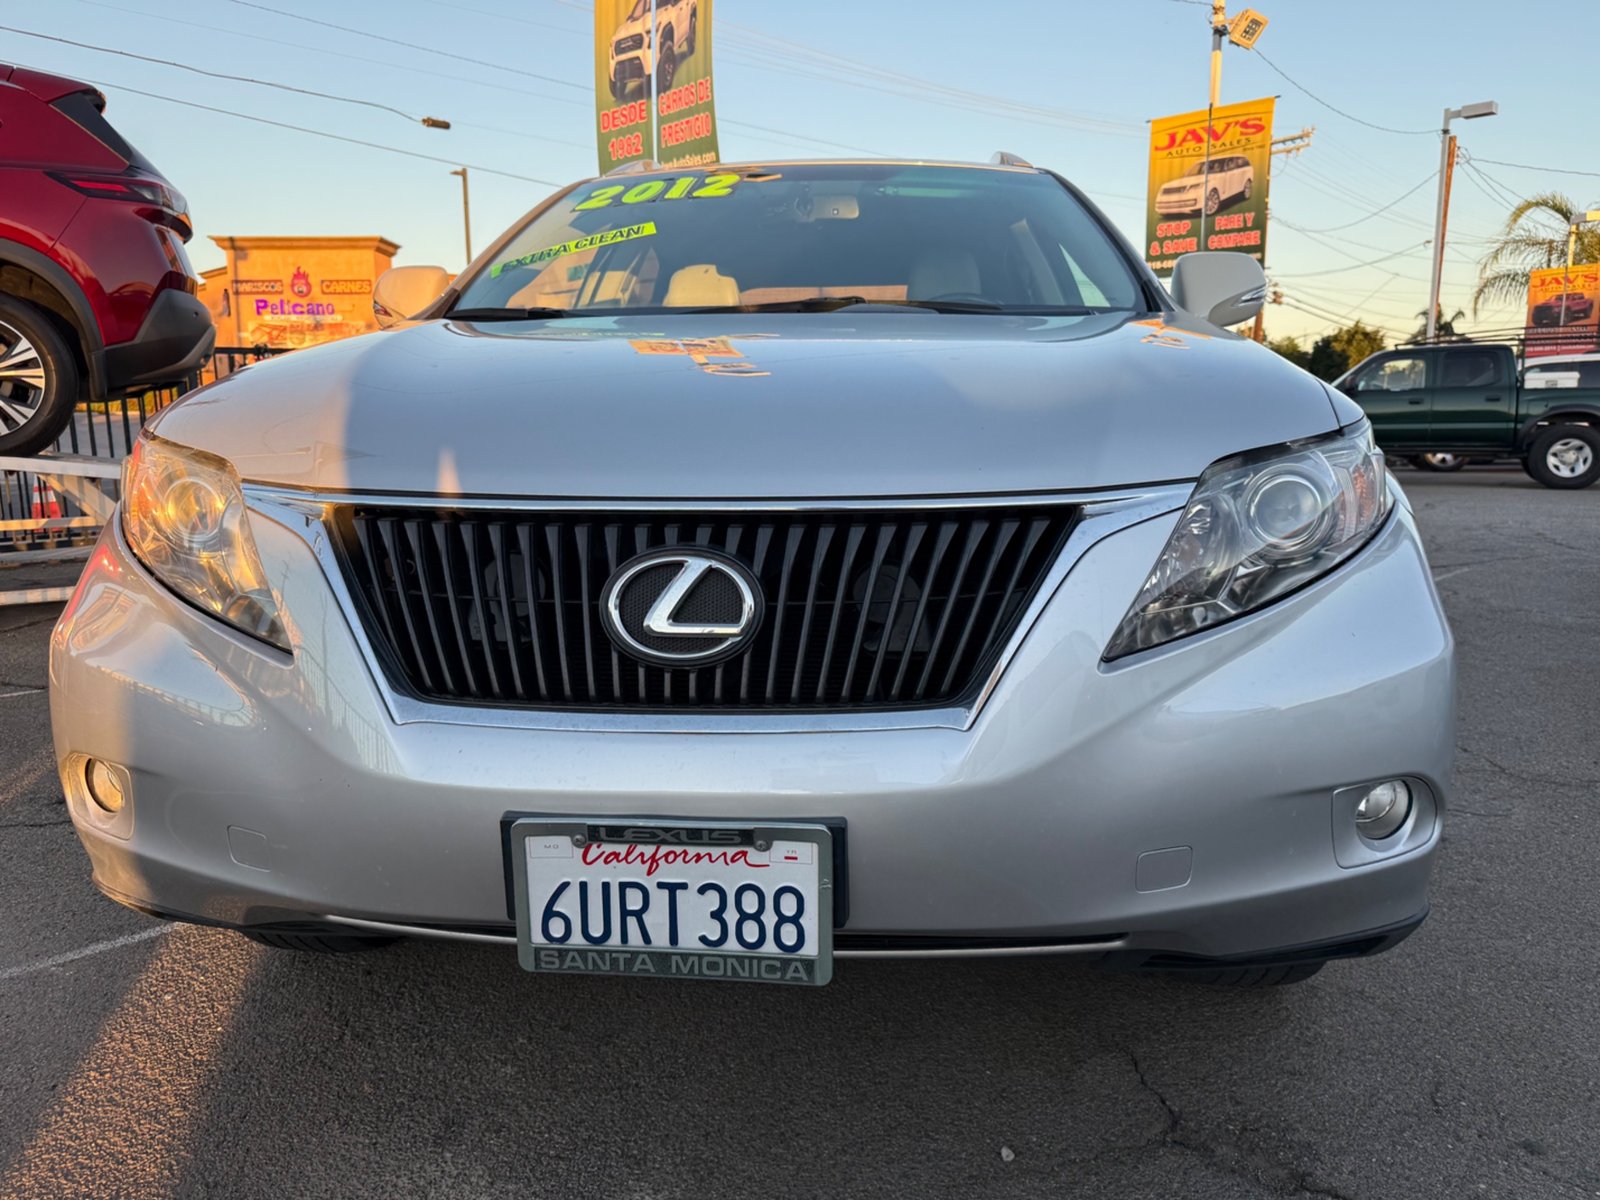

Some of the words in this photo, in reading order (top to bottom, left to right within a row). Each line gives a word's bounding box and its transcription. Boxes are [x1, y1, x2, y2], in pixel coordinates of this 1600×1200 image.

[658, 82, 697, 116] CARROS
[697, 76, 711, 103] DE
[600, 99, 647, 133] DESDE
[660, 112, 712, 148] PRESTIGIO
[608, 132, 643, 161] 1982
[1154, 117, 1265, 152] JAV'S
[1166, 146, 1202, 157] AUTO
[1210, 137, 1252, 150] SALES
[571, 174, 741, 212] 2012
[1156, 220, 1191, 238] STOP
[1215, 214, 1244, 231] PARE
[1244, 212, 1255, 227] Y
[1149, 241, 1161, 256] &
[1162, 237, 1197, 254] SAVE
[1208, 230, 1261, 249] COMPARE
[499, 243, 571, 274] EXTRA
[322, 281, 371, 293] CARNES
[255, 298, 335, 316] Pelicano
[600, 827, 741, 844] LEXUS
[582, 842, 770, 876] California
[541, 880, 806, 954] 6URT388
[539, 951, 656, 974] SANTA
[670, 955, 810, 981] MONICA
